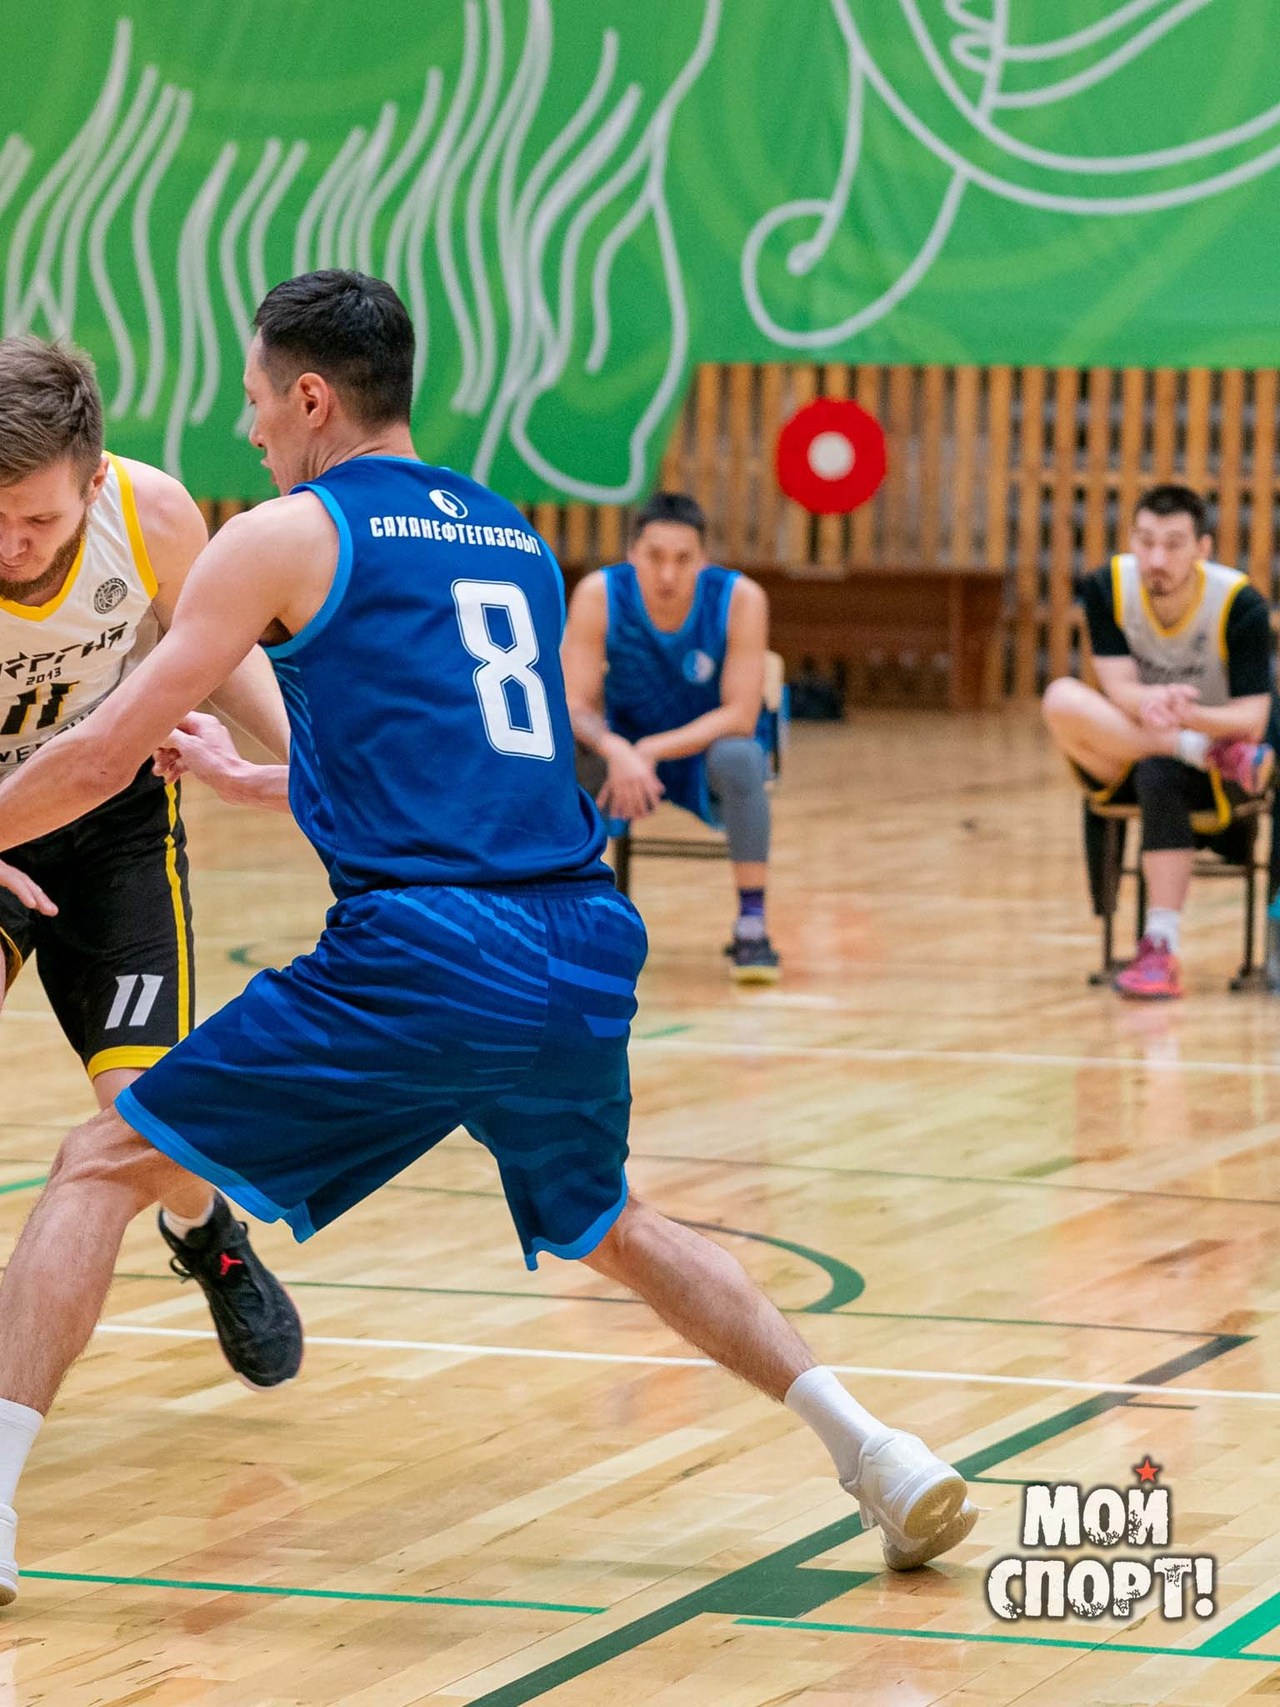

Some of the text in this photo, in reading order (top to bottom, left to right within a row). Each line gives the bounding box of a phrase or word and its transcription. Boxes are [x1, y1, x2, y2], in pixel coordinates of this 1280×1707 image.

[25, 666, 62, 686] 2013
[450, 577, 556, 762] 8
[103, 973, 165, 1031] 11
